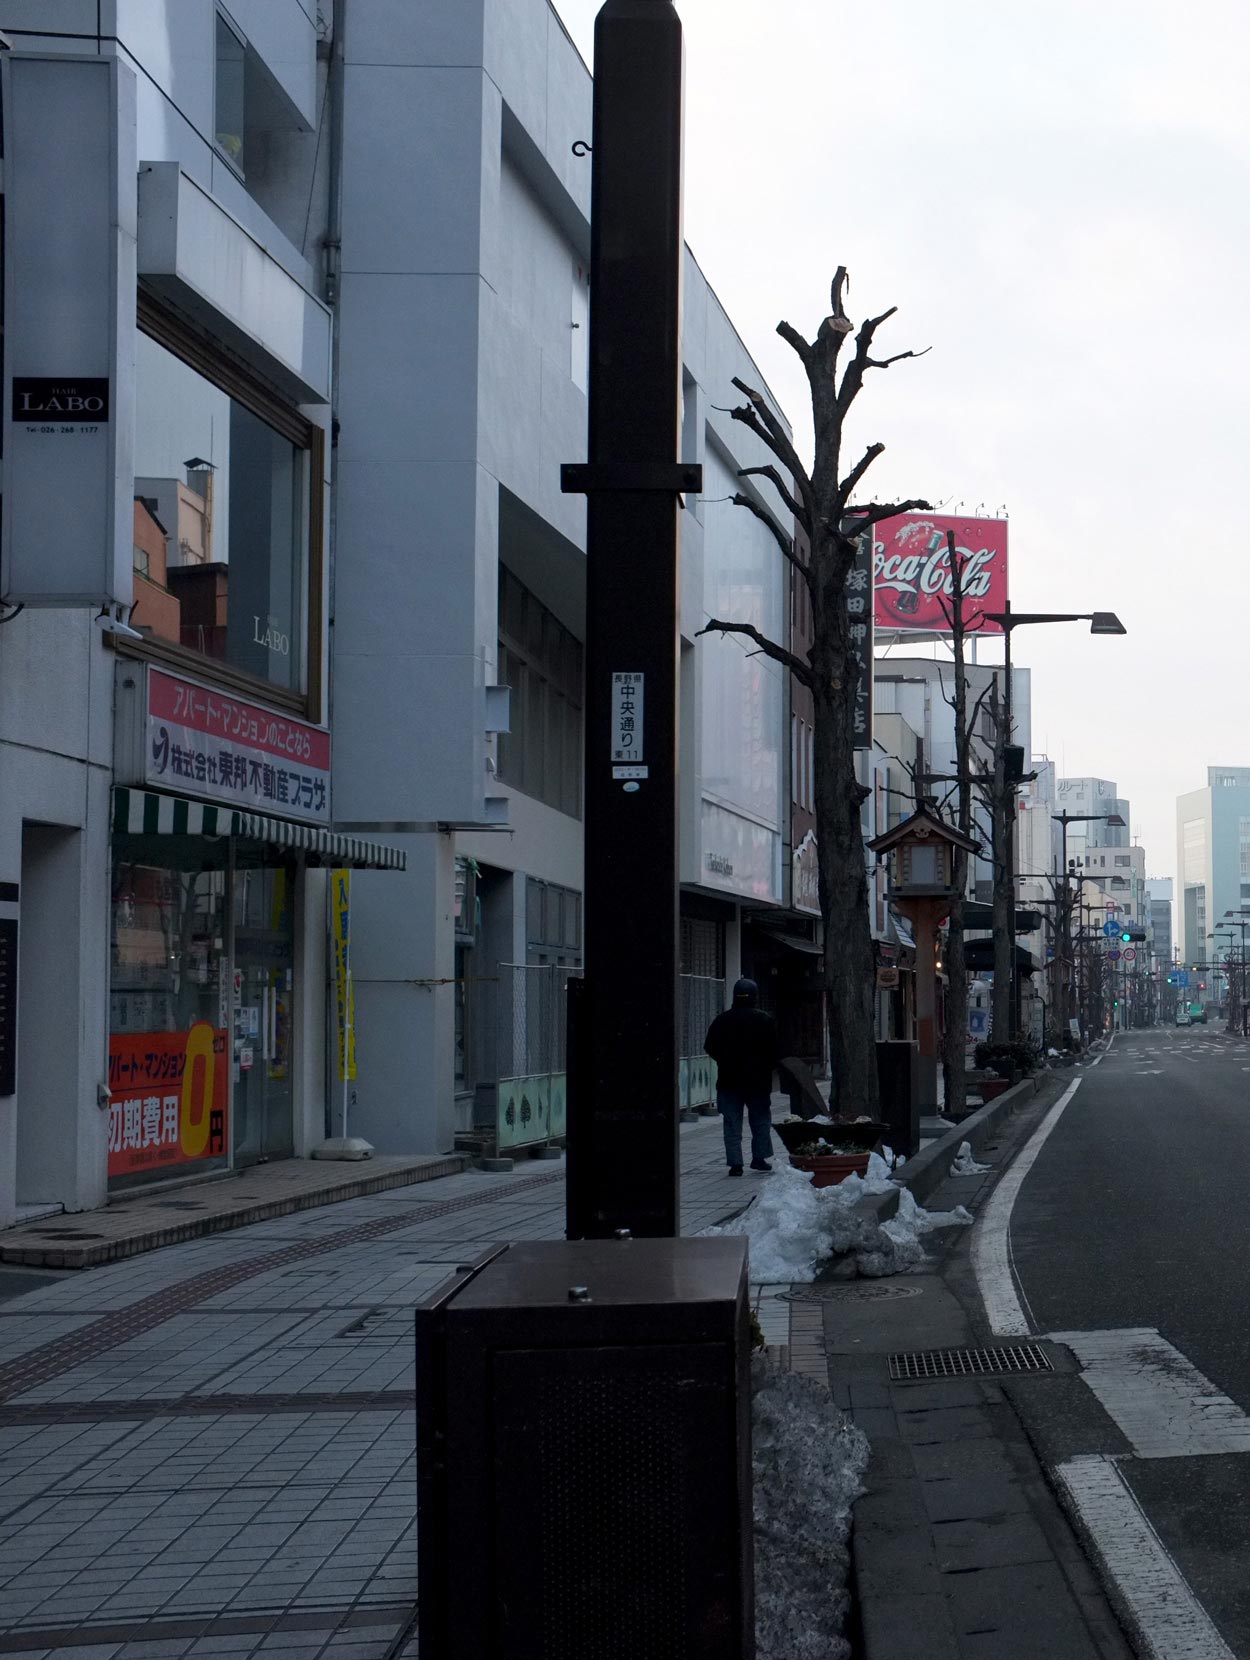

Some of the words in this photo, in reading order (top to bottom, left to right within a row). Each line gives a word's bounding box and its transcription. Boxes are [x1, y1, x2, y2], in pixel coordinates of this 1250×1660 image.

[19, 392, 104, 411] LABO
[253, 616, 289, 656] LABO
[614, 674, 642, 684] 長野県
[173, 686, 311, 759] アパート・マンションのことなら
[620, 685, 635, 747] 中央通り
[171, 743, 326, 811] 株式会社東邦不動産プラザ
[210, 1110, 223, 1154] 円
